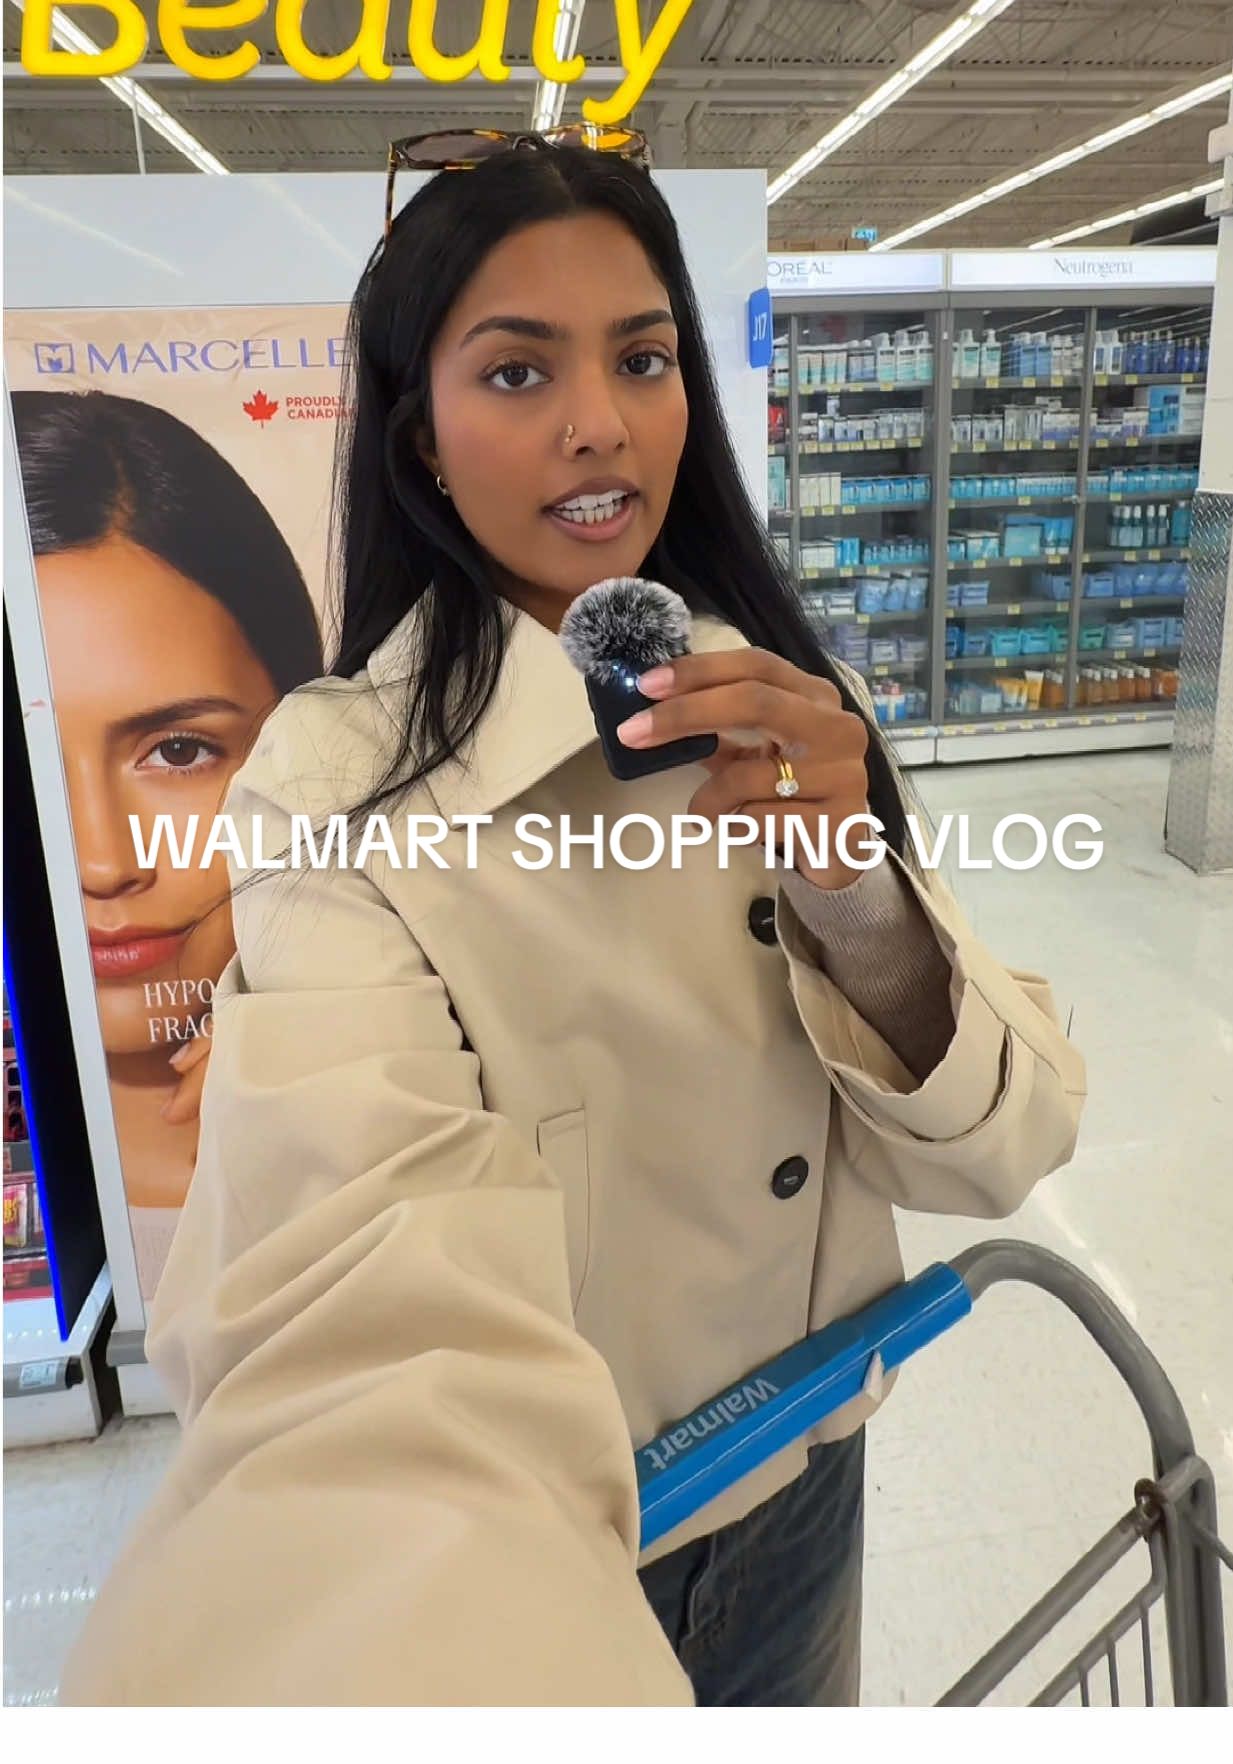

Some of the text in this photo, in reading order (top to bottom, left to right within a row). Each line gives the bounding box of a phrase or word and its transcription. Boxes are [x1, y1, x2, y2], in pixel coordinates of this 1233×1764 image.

[20, 0, 694, 124] Beauty
[1053, 257, 1134, 278] Neutrogena
[752, 312, 768, 341] J17
[86, 337, 354, 374] MARCELLE
[143, 977, 216, 1009] HYPO
[643, 1377, 781, 1470] Walmart
